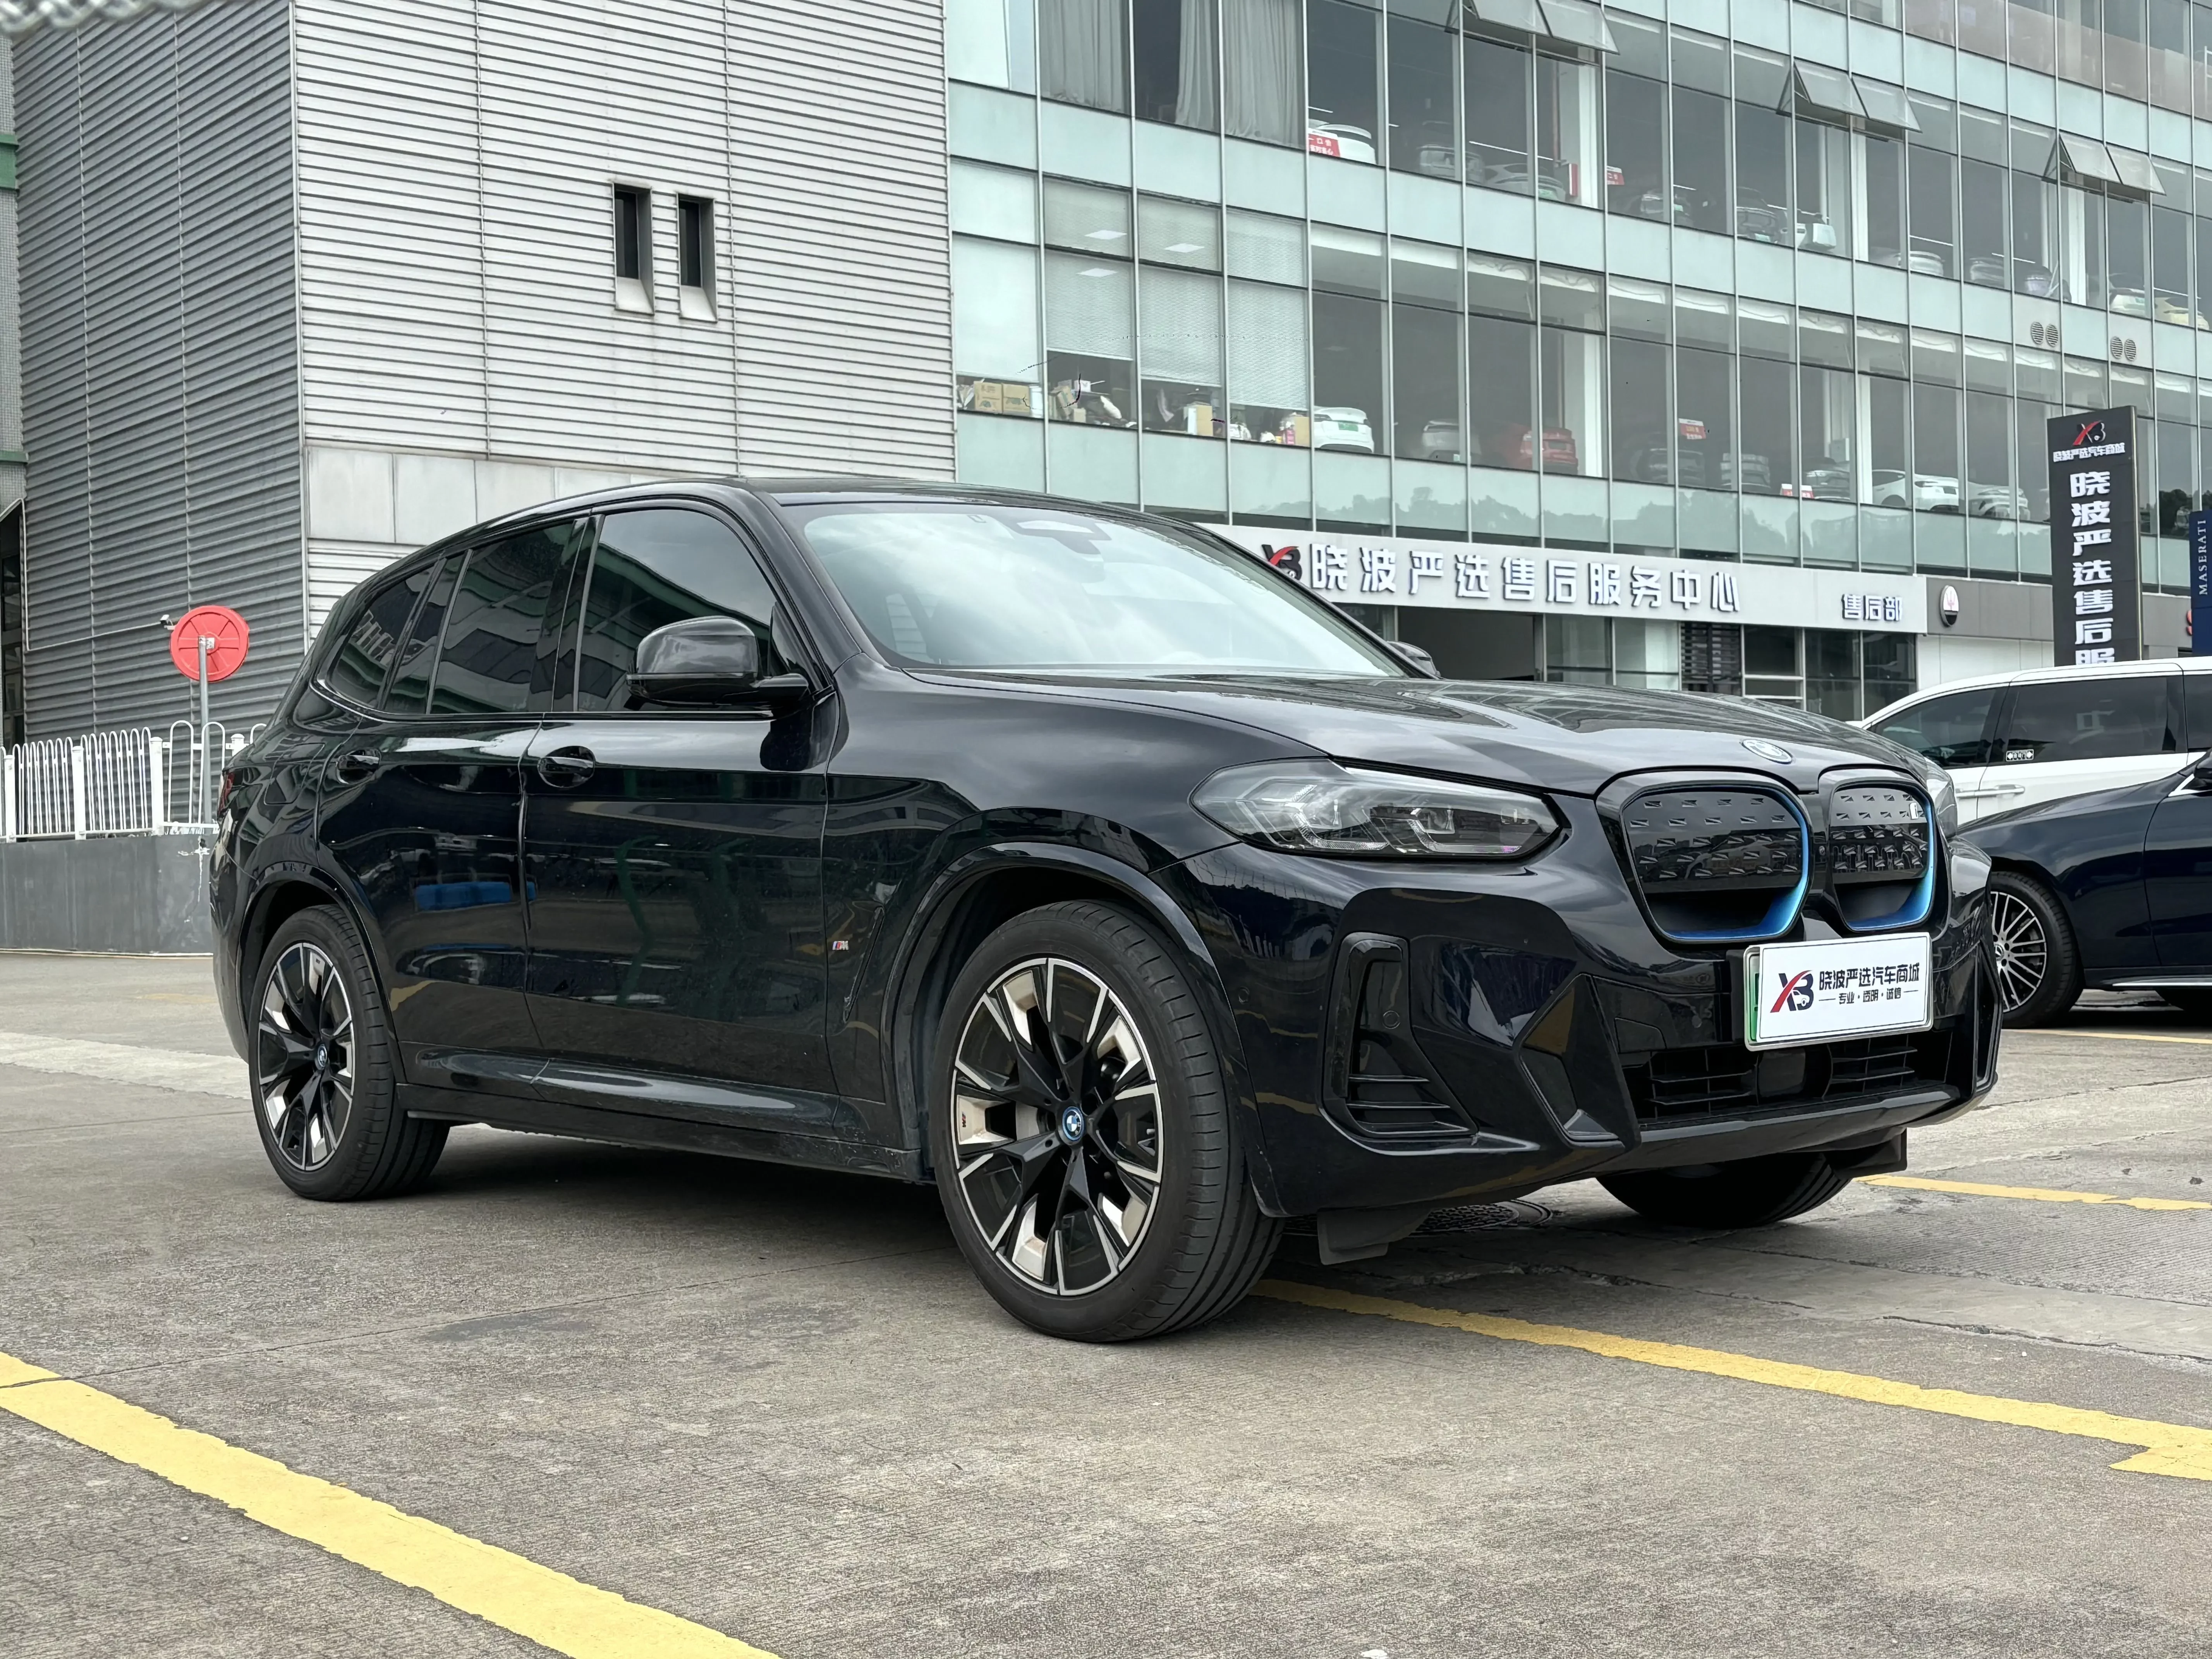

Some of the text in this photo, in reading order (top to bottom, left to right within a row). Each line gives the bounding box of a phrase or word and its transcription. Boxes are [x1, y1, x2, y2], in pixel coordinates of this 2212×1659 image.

[1309, 543, 1741, 612] 晓波严选售后服务中心
[2197, 520, 2208, 595] MASERATI
[1841, 594, 1903, 621] 售后部
[1819, 962, 1920, 991] 晓波严选汽车商城
